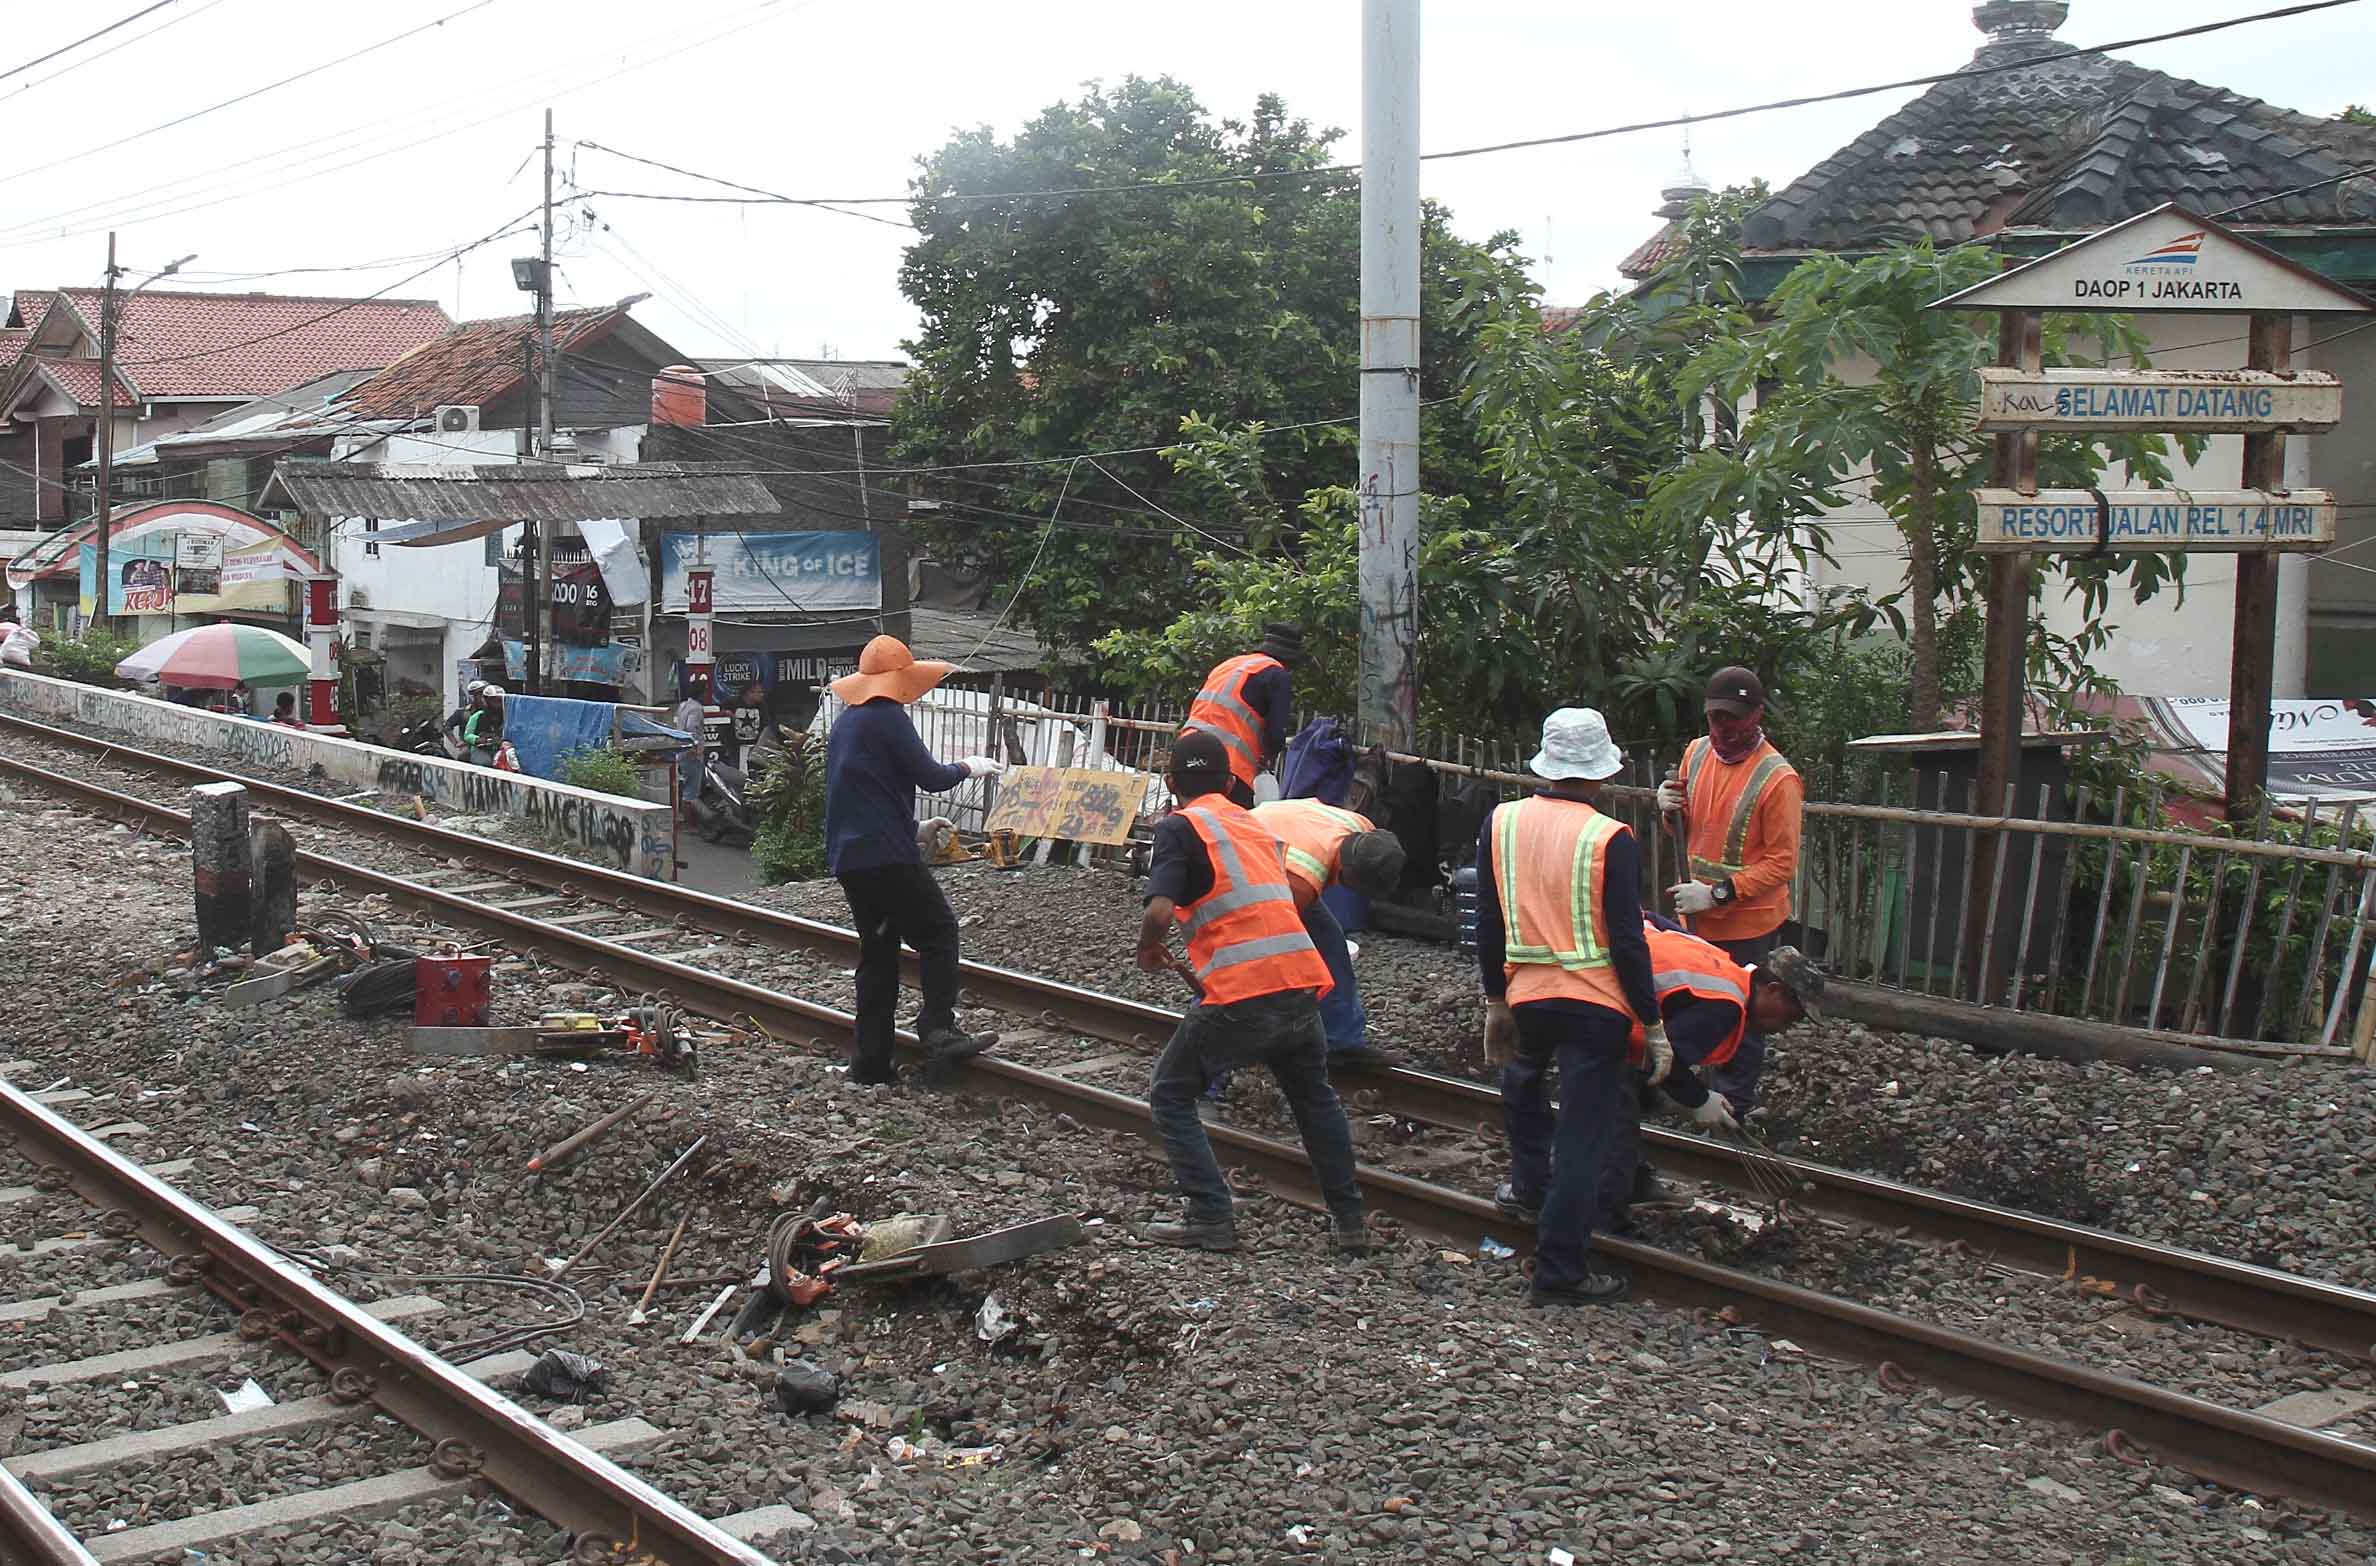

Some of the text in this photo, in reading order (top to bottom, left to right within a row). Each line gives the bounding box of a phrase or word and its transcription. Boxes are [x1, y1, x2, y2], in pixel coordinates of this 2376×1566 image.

[2126, 266, 2193, 276] KERETA API
[2074, 279, 2242, 299] DAOP 1 JAKARTA
[2056, 387, 2273, 417] SELAMAT DATANG
[2001, 507, 2313, 537] RESORT JALAN REL 1.4 MRI
[735, 553, 870, 577] KING OF ICE
[585, 584, 599, 600] 16
[689, 579, 708, 604] 17
[689, 627, 707, 652] 08
[722, 671, 752, 682] STRIKE
[724, 663, 751, 673] LUCKY
[786, 658, 827, 681] MILD
